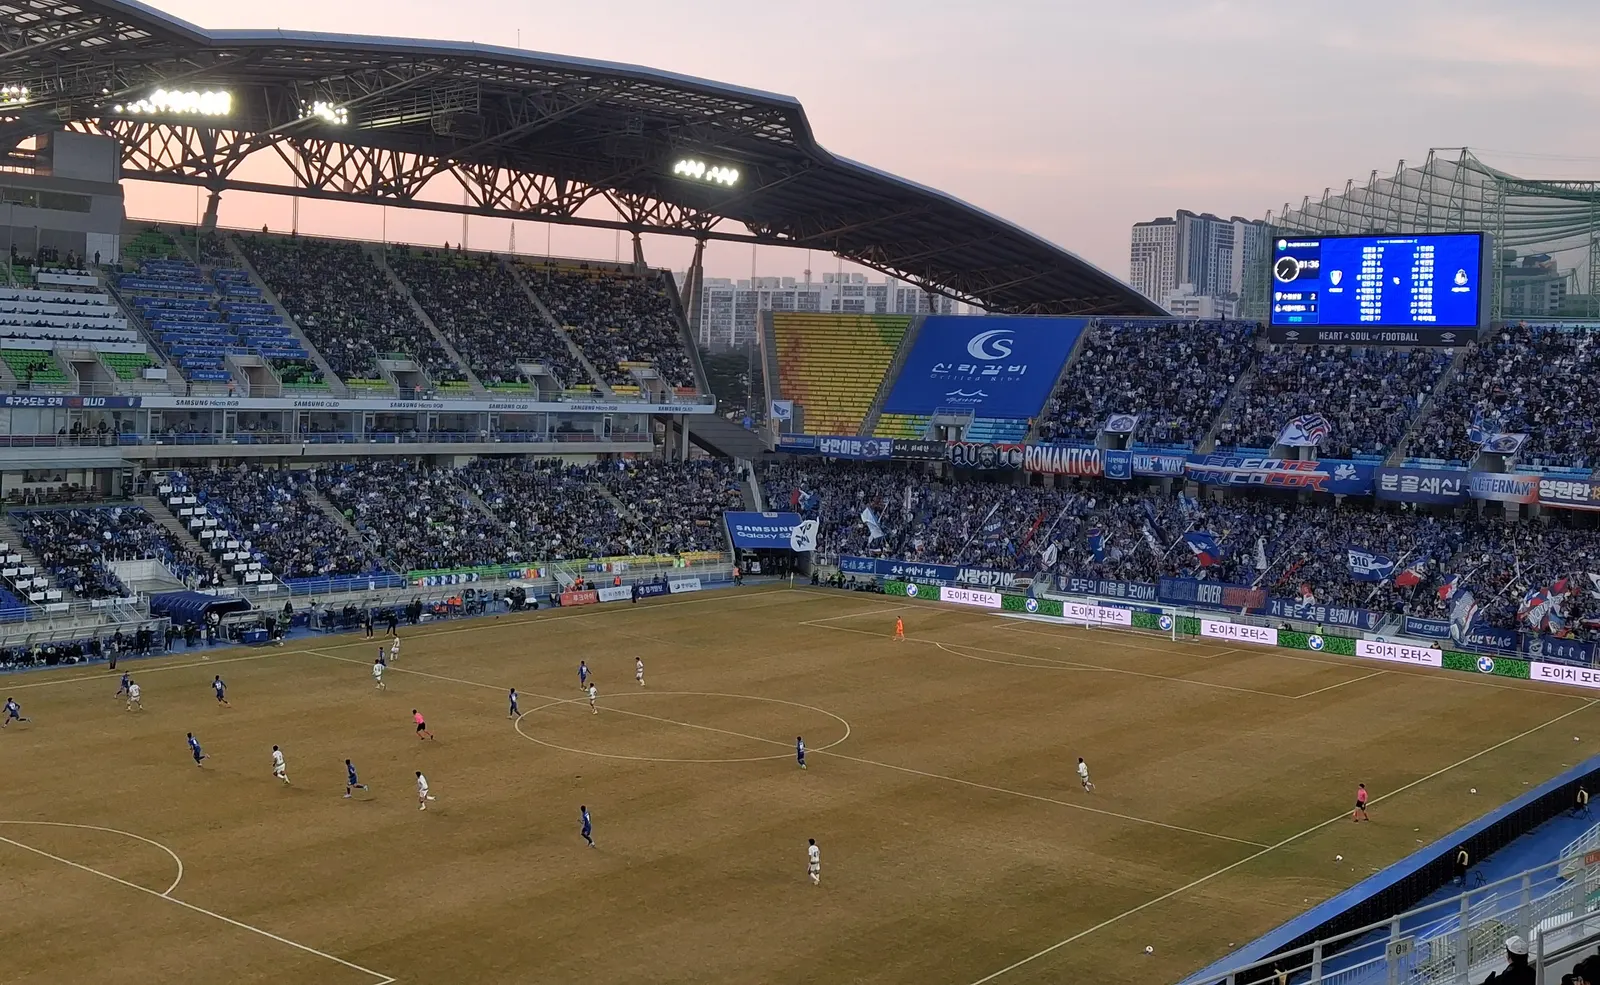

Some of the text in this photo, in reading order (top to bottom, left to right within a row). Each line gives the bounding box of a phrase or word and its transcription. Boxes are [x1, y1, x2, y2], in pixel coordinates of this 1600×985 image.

[1318, 331, 1343, 341] HEART
[1350, 331, 1371, 341] SOUL
[1381, 332, 1419, 342] FOOTBALL
[931, 362, 1028, 375] 신라갈비
[820, 438, 862, 456] 낭만이란
[1025, 445, 1101, 475] ROMANTICO
[1132, 457, 1154, 471] BLUE
[1188, 470, 1330, 493] TRICOLOR
[1381, 473, 1461, 496] 분골쇄신
[1539, 479, 1591, 502] 영원한
[737, 531, 793, 540] Galaxy S2
[1350, 555, 1369, 568] 310
[946, 589, 995, 605] 도이치 모터스
[1070, 577, 1156, 601] 모두의 마음을 모아서
[1197, 583, 1221, 605] NEVER
[1070, 605, 1097, 618] 도이치
[1098, 608, 1124, 622] 모터스
[1271, 600, 1281, 616] 저
[1329, 608, 1359, 626] 향해서
[1209, 623, 1269, 641] 도이치 모터스
[1365, 643, 1433, 663] 도이치 모터스
[1540, 666, 1577, 682] 도이치
